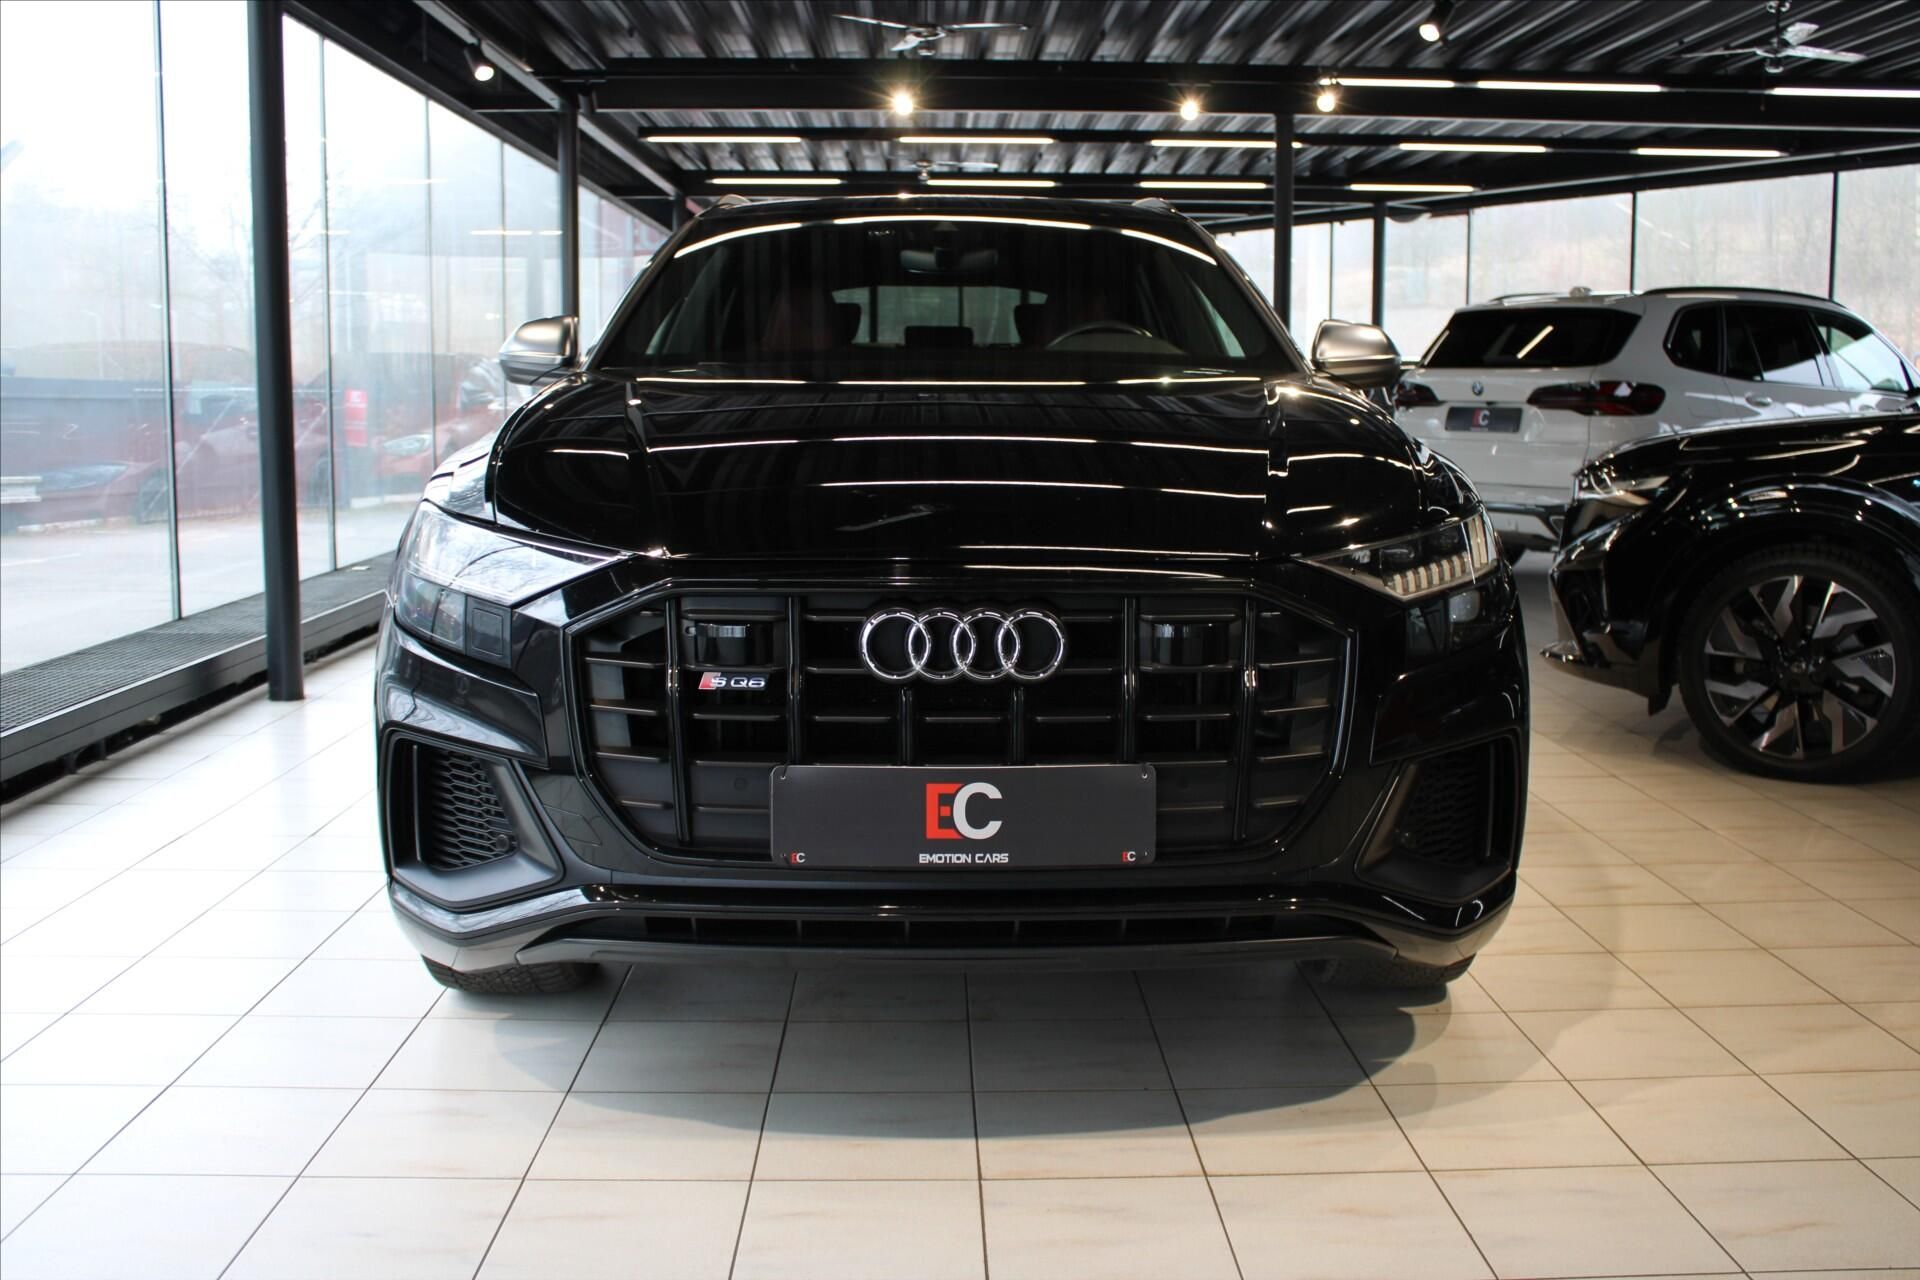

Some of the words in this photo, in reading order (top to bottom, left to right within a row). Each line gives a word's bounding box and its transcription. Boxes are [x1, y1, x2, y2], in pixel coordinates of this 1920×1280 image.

[926, 782, 1003, 840] EC
[919, 853, 972, 864] EMOTION
[975, 853, 1009, 864] CARS
